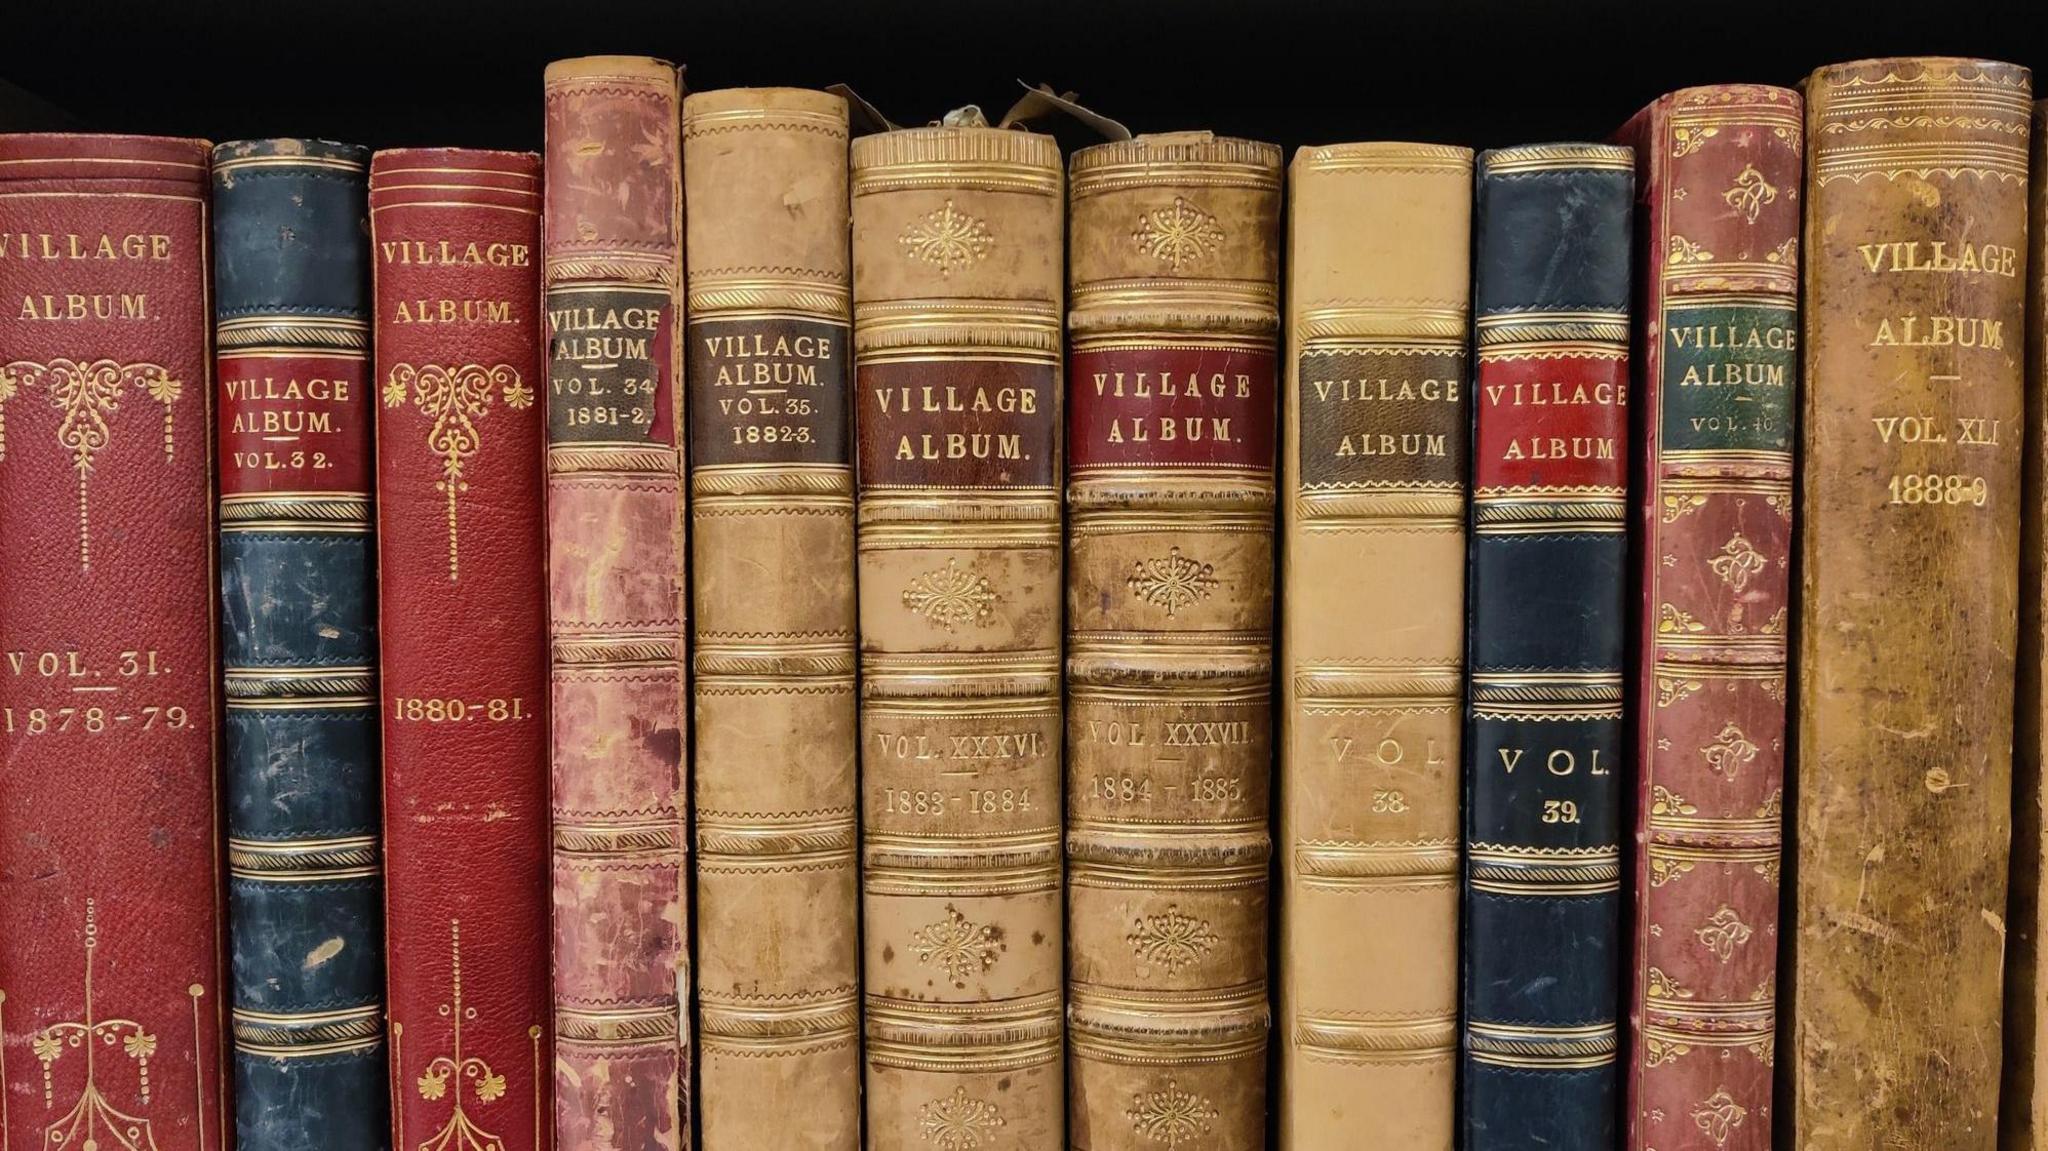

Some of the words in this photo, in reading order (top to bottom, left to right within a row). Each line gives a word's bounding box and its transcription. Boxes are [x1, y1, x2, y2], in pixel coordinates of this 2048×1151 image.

[381, 241, 529, 267] VILLAGE
[1857, 241, 2016, 278] VILLAGE
[18, 294, 160, 320] ALBUM.
[393, 300, 520, 324] ALBUM.
[549, 308, 661, 332] VILLAGE
[1670, 326, 1796, 351] VILLAGE
[1870, 316, 2004, 350] ALBUM
[556, 337, 648, 361] ALBUM
[705, 335, 831, 359] VILLAGE
[553, 378, 611, 395] VOL.
[714, 363, 824, 386] ALBUM.
[1093, 372, 1250, 398] VILLAGE
[1680, 363, 1785, 387] ALBUM
[225, 377, 349, 401] VILLAGE
[875, 386, 1036, 414] VILLAGE
[1313, 379, 1459, 402] VILLAGE
[1486, 383, 1627, 406] VILLAGE
[567, 406, 652, 426] 1881-2.
[719, 398, 780, 416] VOL.
[231, 411, 341, 433] ALBUM.
[1107, 417, 1242, 443] ALBUM.
[1690, 417, 1747, 432] VOL.
[1872, 416, 1947, 443] VOL.
[1956, 416, 2000, 446] XLI
[733, 426, 816, 444] 1882-3.
[895, 433, 1031, 460] ALBUM.
[1335, 434, 1446, 456] ALBUM
[1503, 436, 1615, 460] ALBUM
[1888, 473, 1988, 507] 1888-9
[8, 651, 101, 677] VOL.
[118, 651, 172, 676] 31.
[4, 706, 195, 734] 1878-79.
[877, 734, 941, 759] VOL.
[949, 733, 1046, 760] XXXVI.
[1541, 800, 1581, 824] 39.
